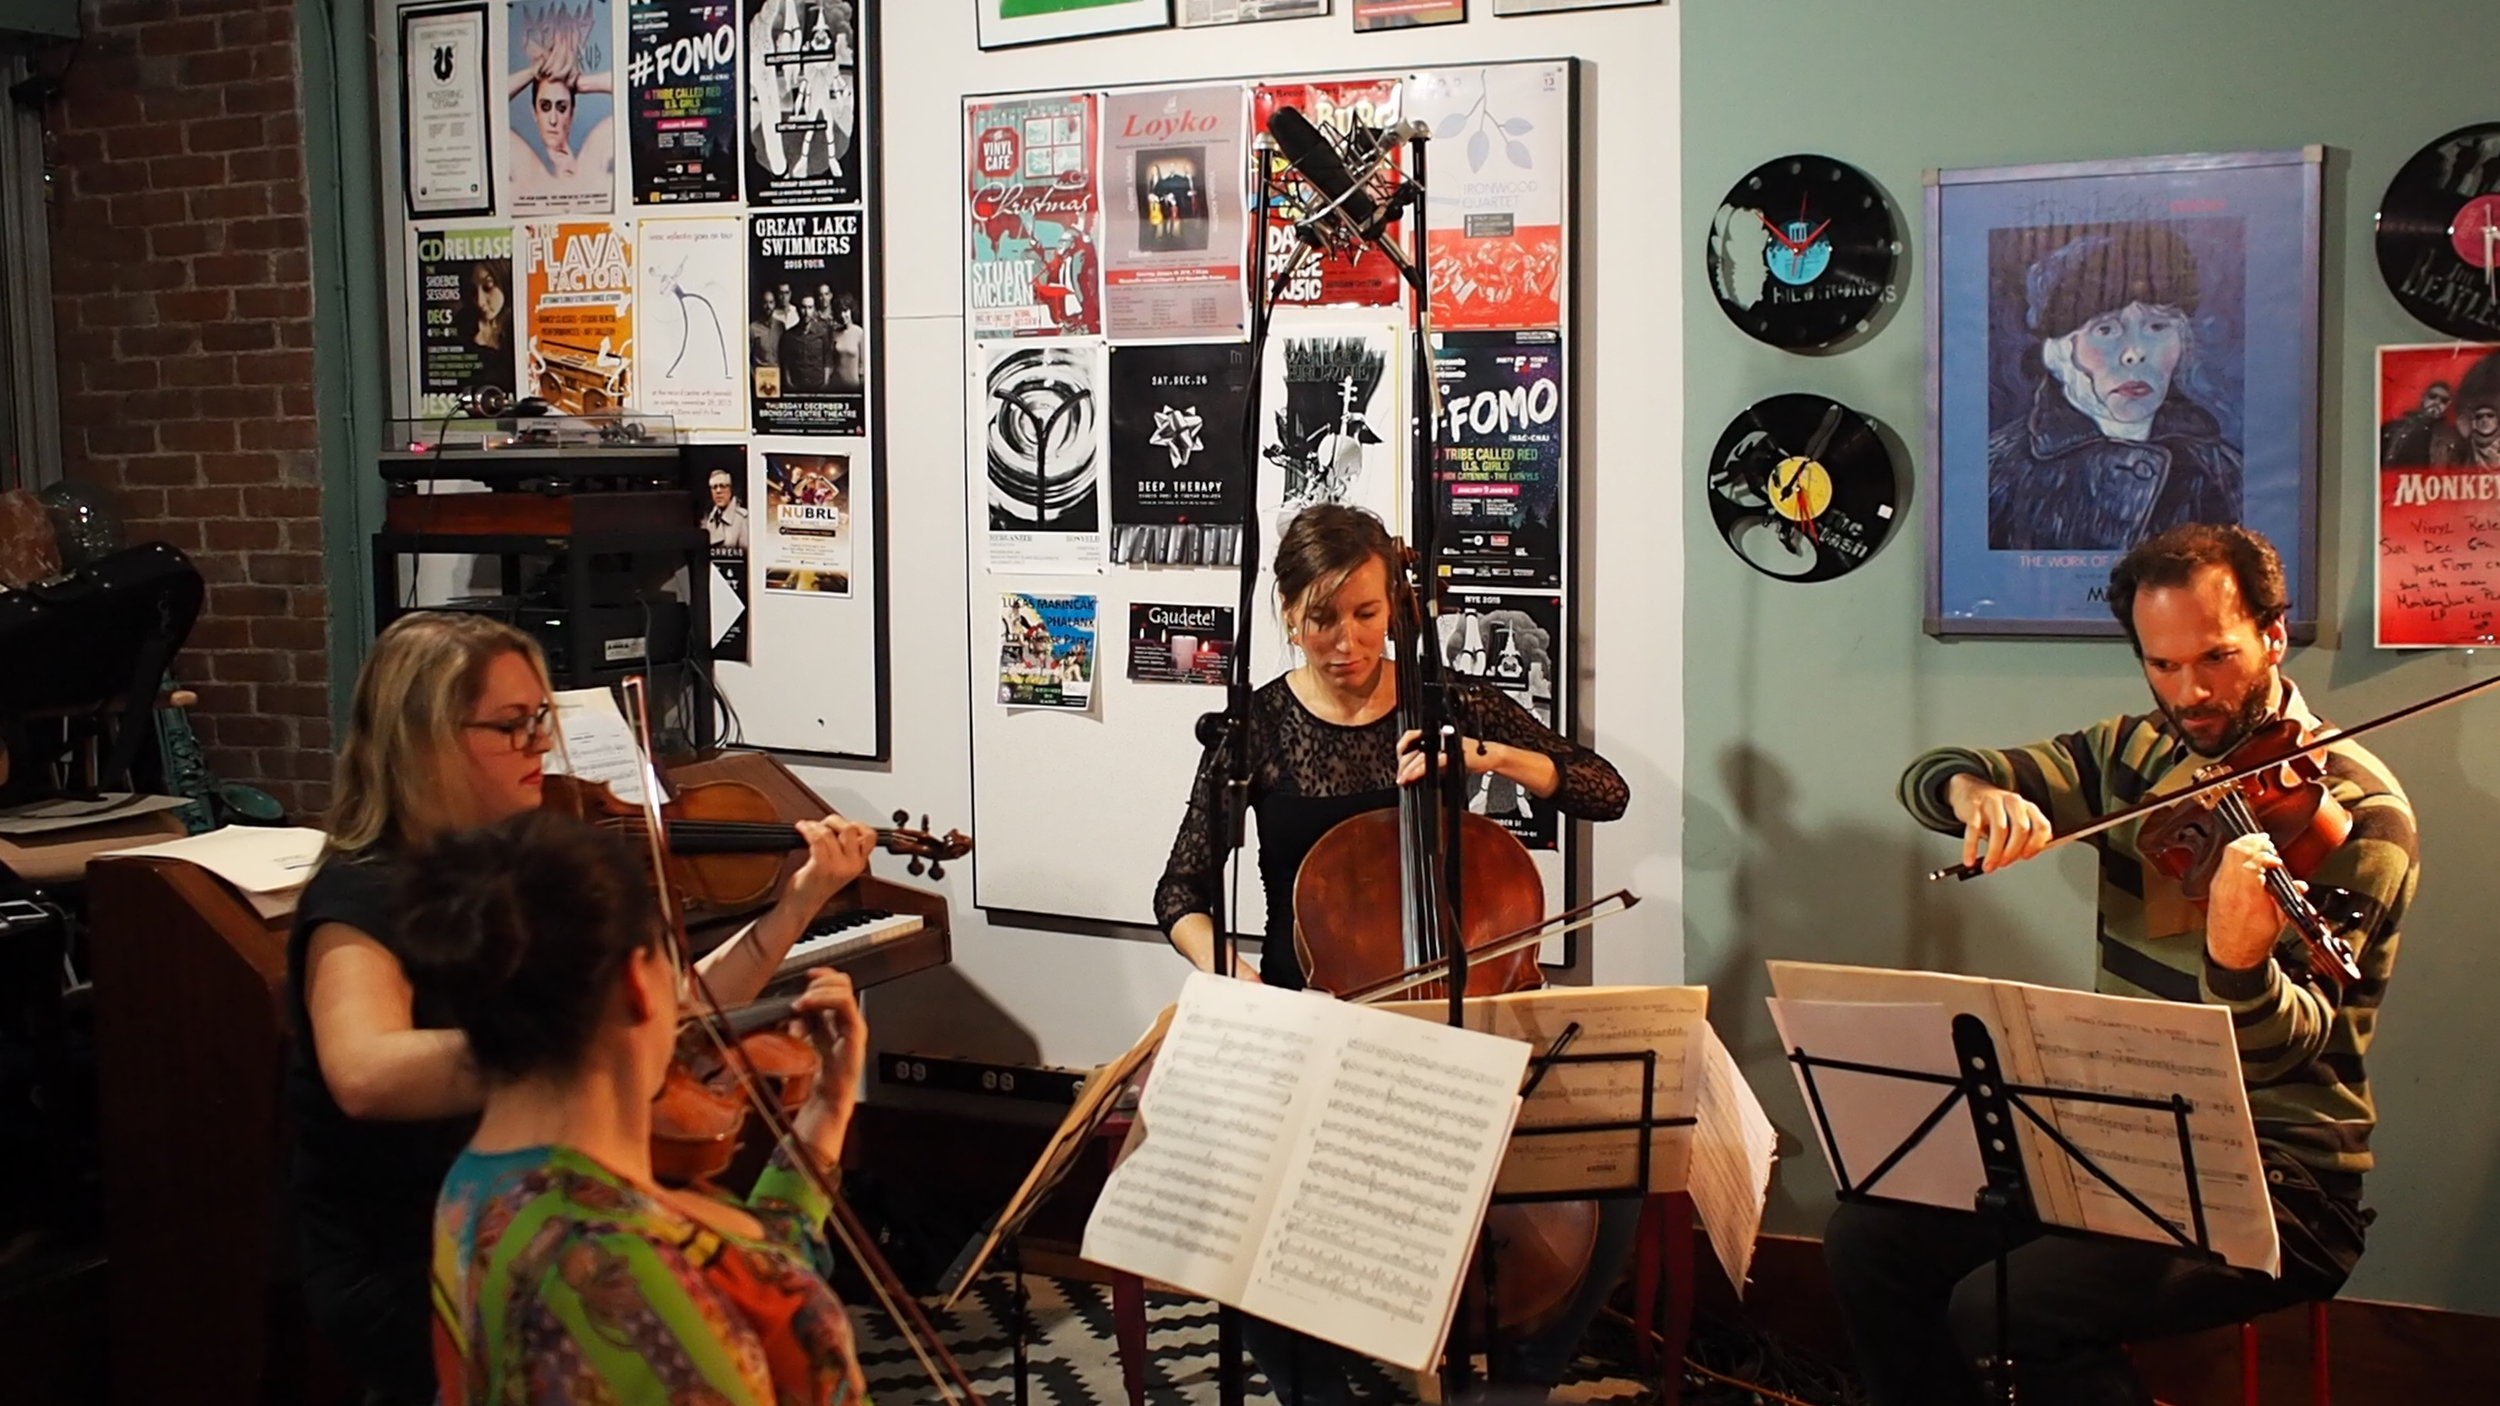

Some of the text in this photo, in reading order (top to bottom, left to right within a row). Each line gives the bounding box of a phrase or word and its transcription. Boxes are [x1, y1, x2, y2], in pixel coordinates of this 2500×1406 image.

[628, 24, 735, 87] #FOMO
[1121, 109, 1218, 141] Loyko
[983, 140, 1014, 157] VINYL
[985, 156, 1011, 171] CAFE
[970, 181, 1093, 222] Christmas
[755, 215, 857, 237] GREAT LAKE
[444, 235, 512, 261] RELEASE
[526, 232, 629, 274] FLAVA
[762, 237, 851, 257] SWIMMERS
[804, 259, 826, 269] TOUR
[972, 259, 1035, 285] STUART
[426, 275, 460, 287] SHOEBOX
[426, 288, 461, 301] SESSIONS
[973, 282, 1034, 309] MCLEAN
[759, 409, 794, 419] BRONSON
[823, 410, 858, 419] THEATRE
[765, 402, 803, 411] THURSDAY
[803, 402, 843, 411] DECEMBER
[1445, 448, 1538, 460] TRIBE CALLED RED
[1482, 460, 1510, 471] GIRLS
[1138, 481, 1222, 492] DEEP THERAPY
[781, 504, 836, 521] NUBRL
[2019, 555, 2109, 568] THE WORK OF
[1464, 595, 1481, 605] NYE
[1046, 616, 1095, 627] PHALANX
[1148, 606, 1216, 627] Gaudete!
